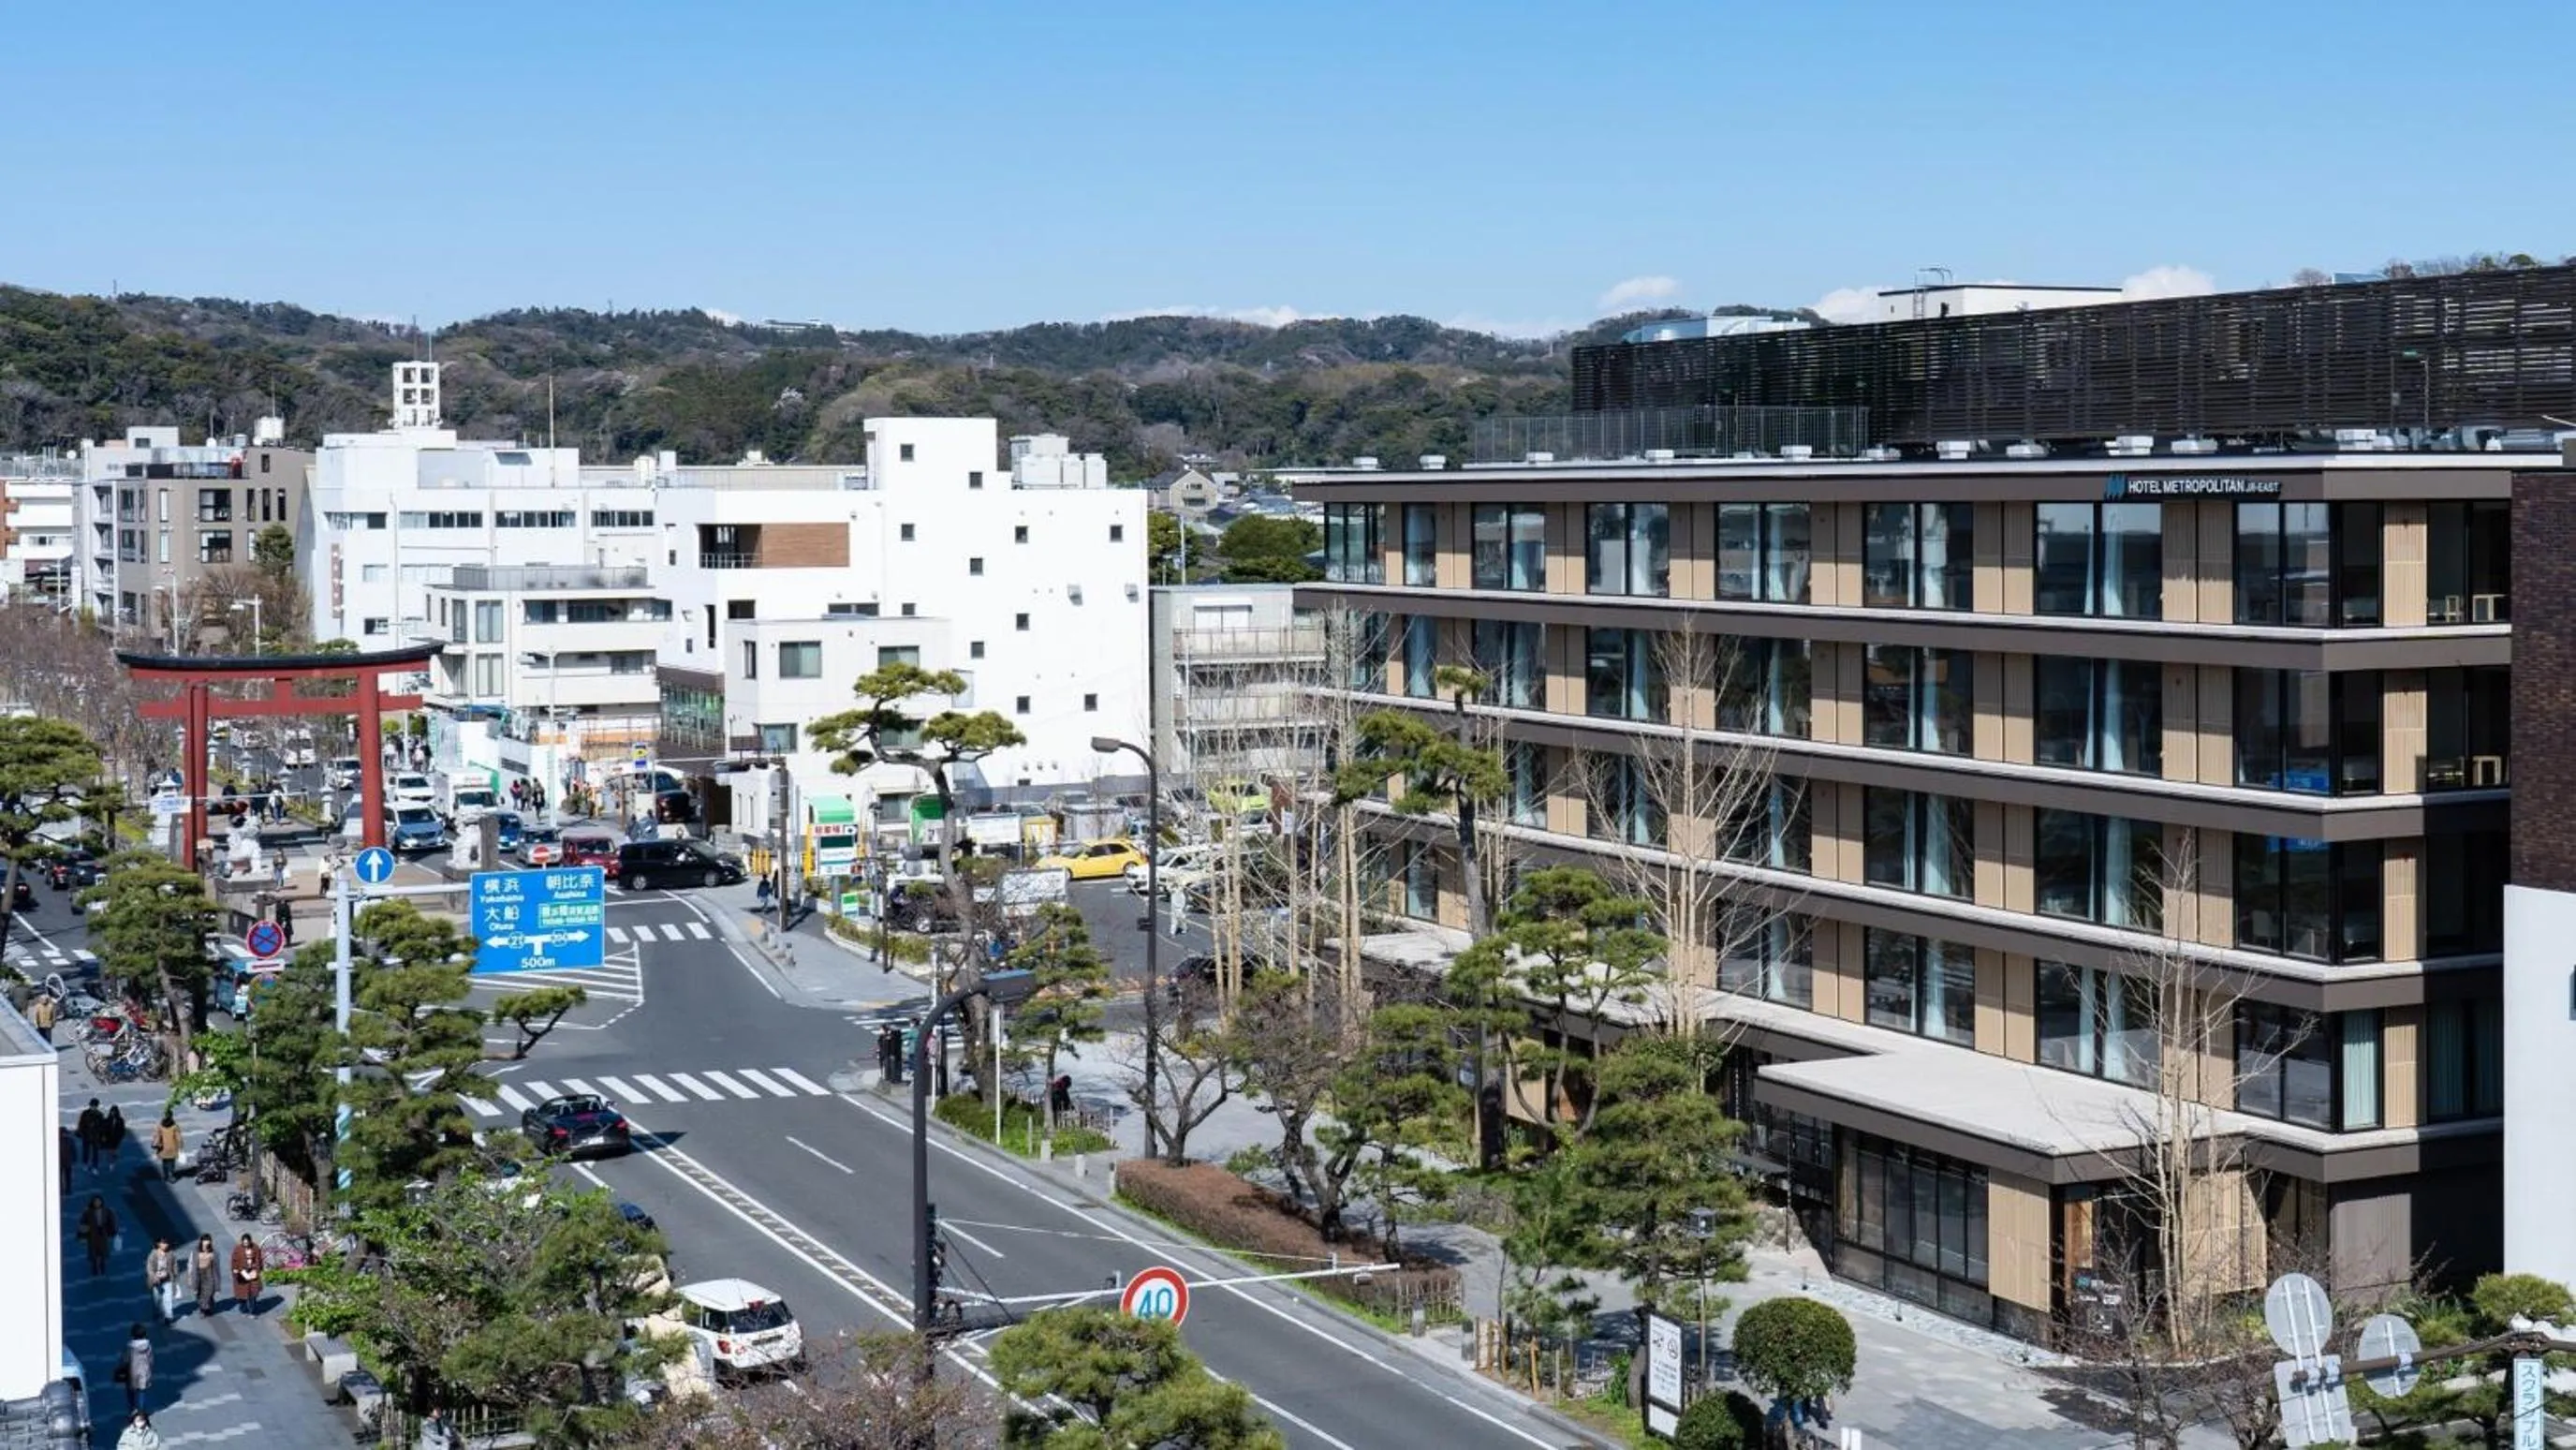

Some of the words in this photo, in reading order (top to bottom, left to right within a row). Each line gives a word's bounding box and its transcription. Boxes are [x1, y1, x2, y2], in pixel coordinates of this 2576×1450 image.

[2128, 480, 2162, 494] HOTEL
[2163, 479, 2244, 494] METROPOLITAN
[484, 878, 520, 894] 横浜
[484, 905, 520, 922] 大船
[522, 956, 555, 968] 500m
[1139, 1287, 1172, 1319] 40
[2522, 1365, 2537, 1450] スクランブル
